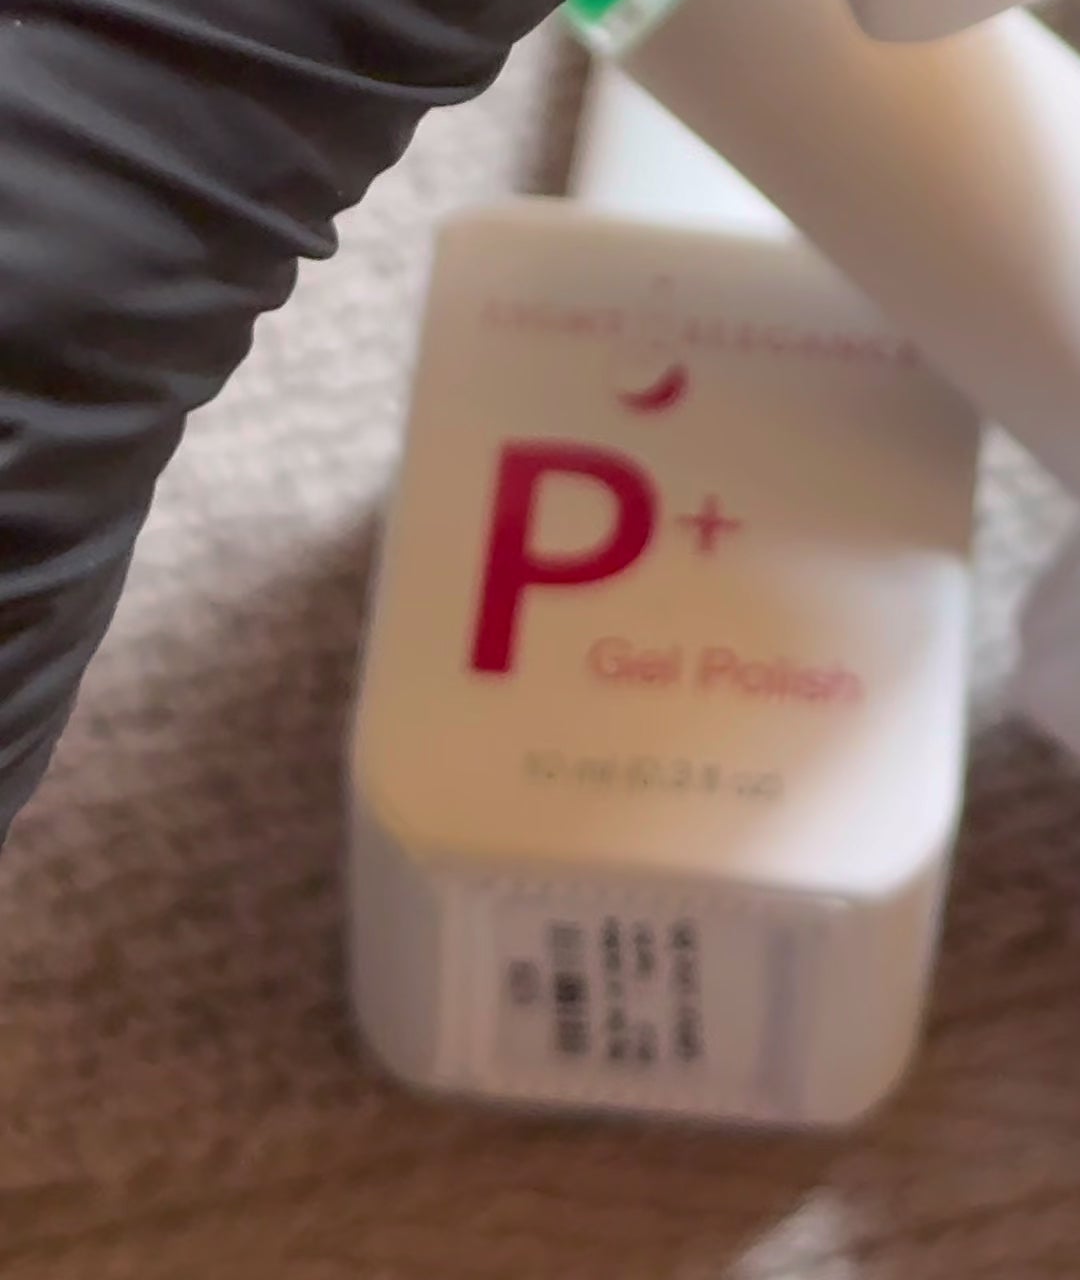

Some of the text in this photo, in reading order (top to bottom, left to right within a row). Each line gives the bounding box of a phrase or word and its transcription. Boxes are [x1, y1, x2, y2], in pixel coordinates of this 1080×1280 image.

[470, 437, 743, 676] P+
[588, 636, 864, 703] Gel Polish
